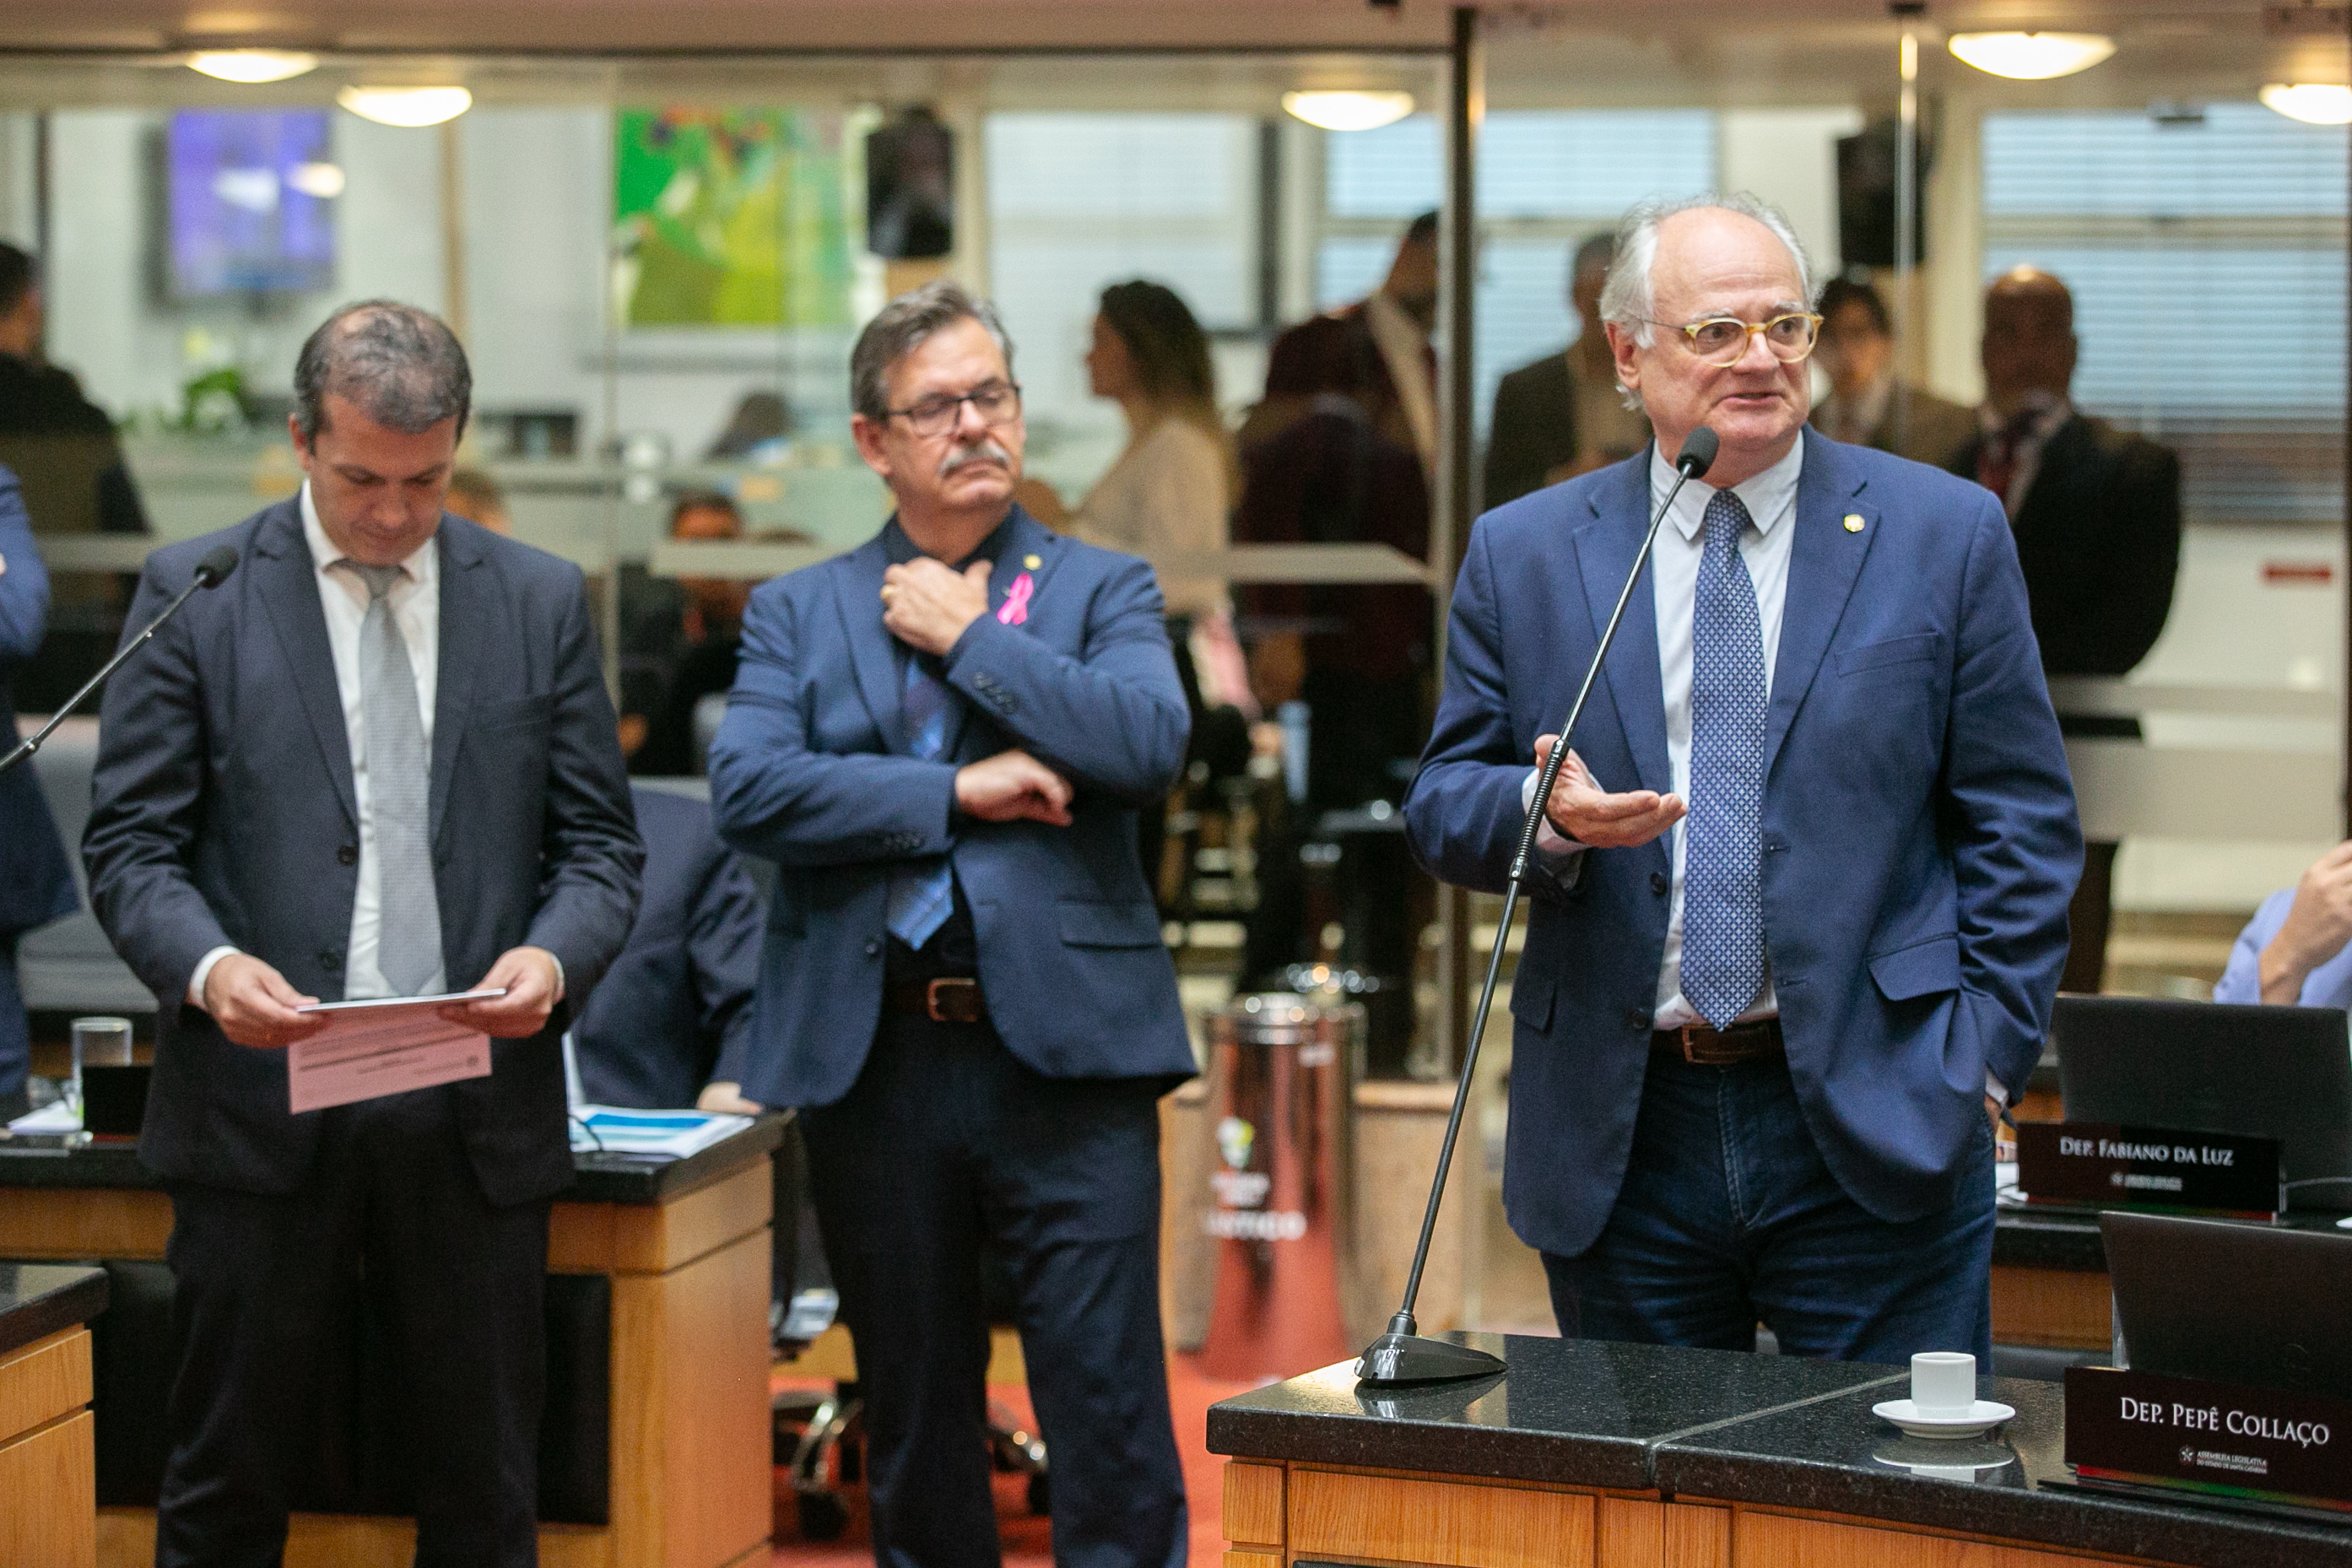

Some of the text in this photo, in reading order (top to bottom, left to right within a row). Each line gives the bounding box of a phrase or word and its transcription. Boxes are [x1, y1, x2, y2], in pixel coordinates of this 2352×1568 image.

[2202, 1146, 2235, 1166] LUZ
[2120, 1397, 2330, 1447] DEP. PEPÊ COLLAÇO
[2197, 1451, 2268, 1467] ASSEMBLEIA LEGISLATIVA
